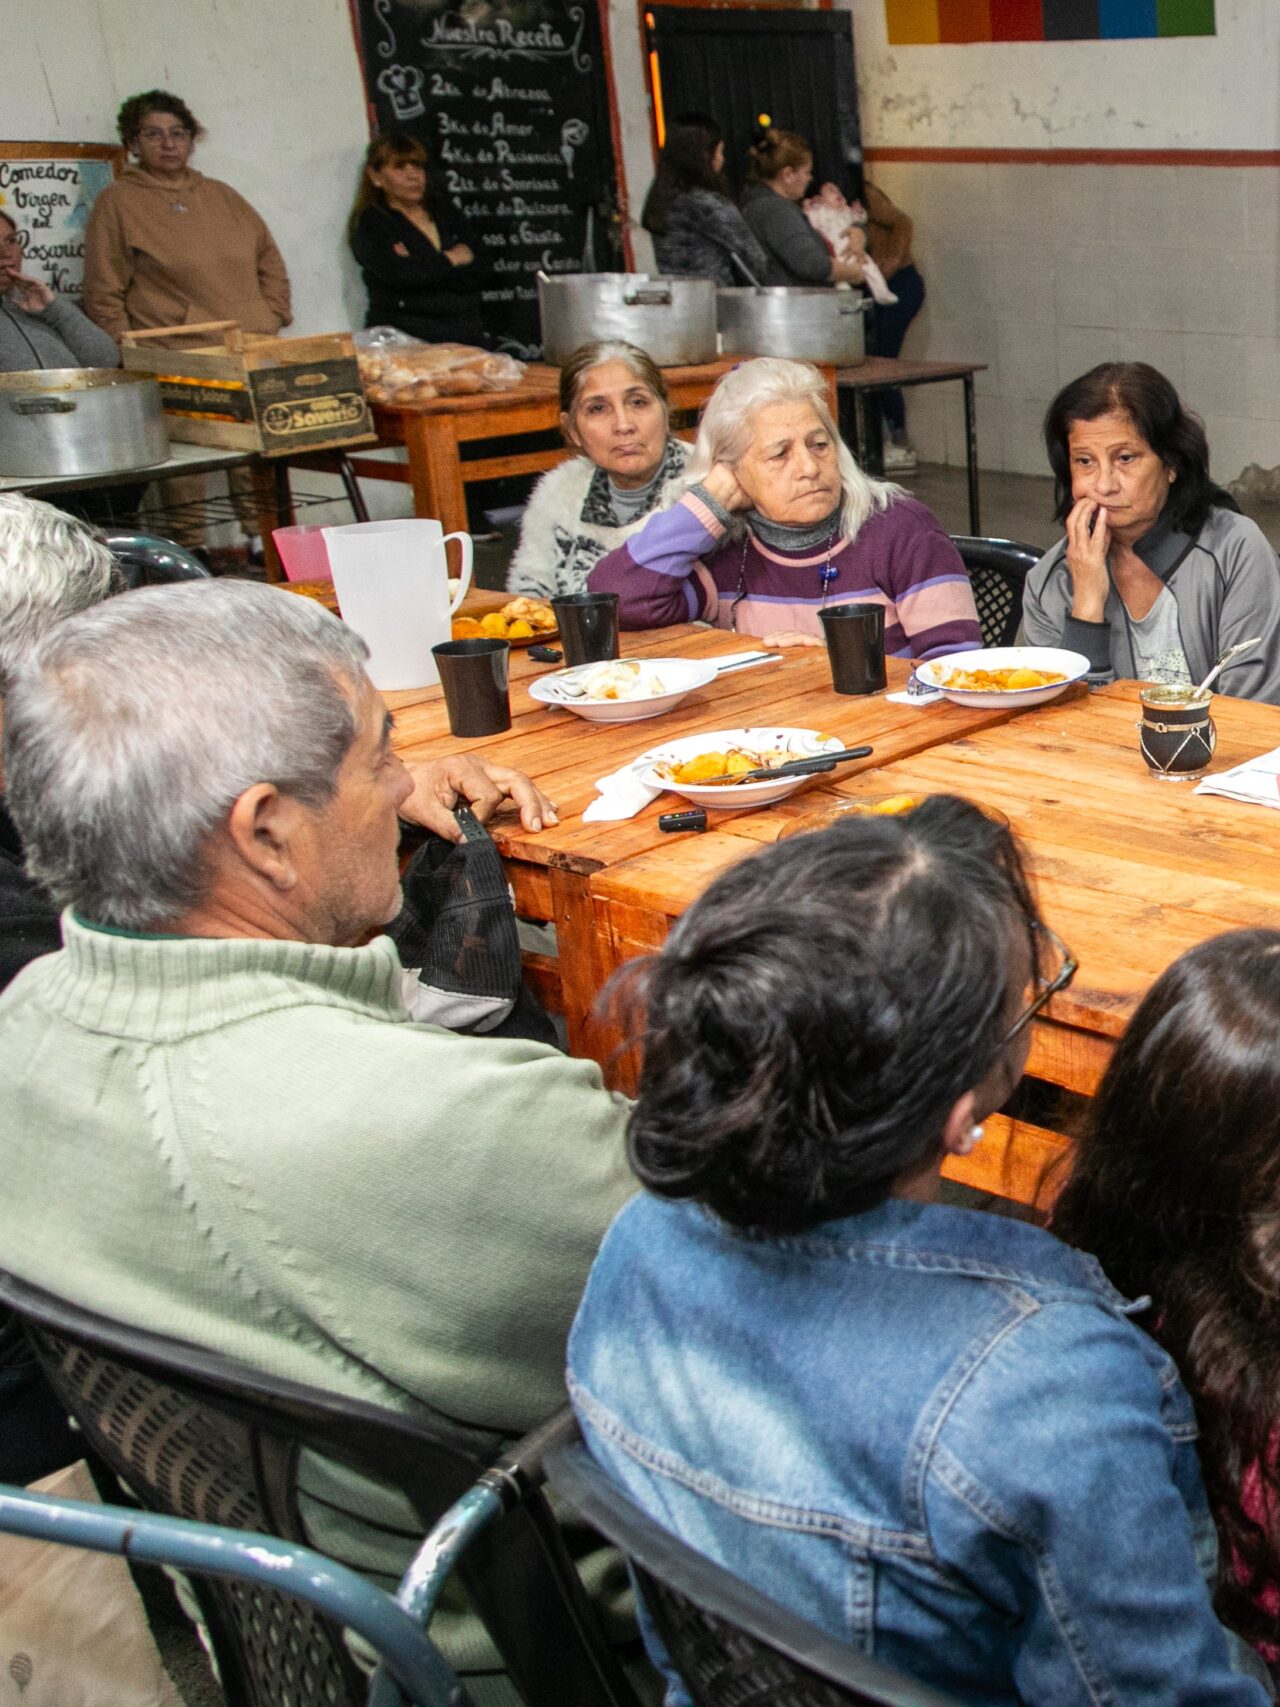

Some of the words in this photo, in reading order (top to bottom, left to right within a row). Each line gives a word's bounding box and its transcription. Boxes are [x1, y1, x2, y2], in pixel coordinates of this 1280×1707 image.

[431, 14, 498, 44] Nuestra
[496, 19, 564, 47] Receta
[472, 121, 489, 134] de
[477, 149, 494, 162] de
[0, 162, 79, 188] Comedor
[482, 177, 499, 191] de
[12, 187, 71, 217] Virgen
